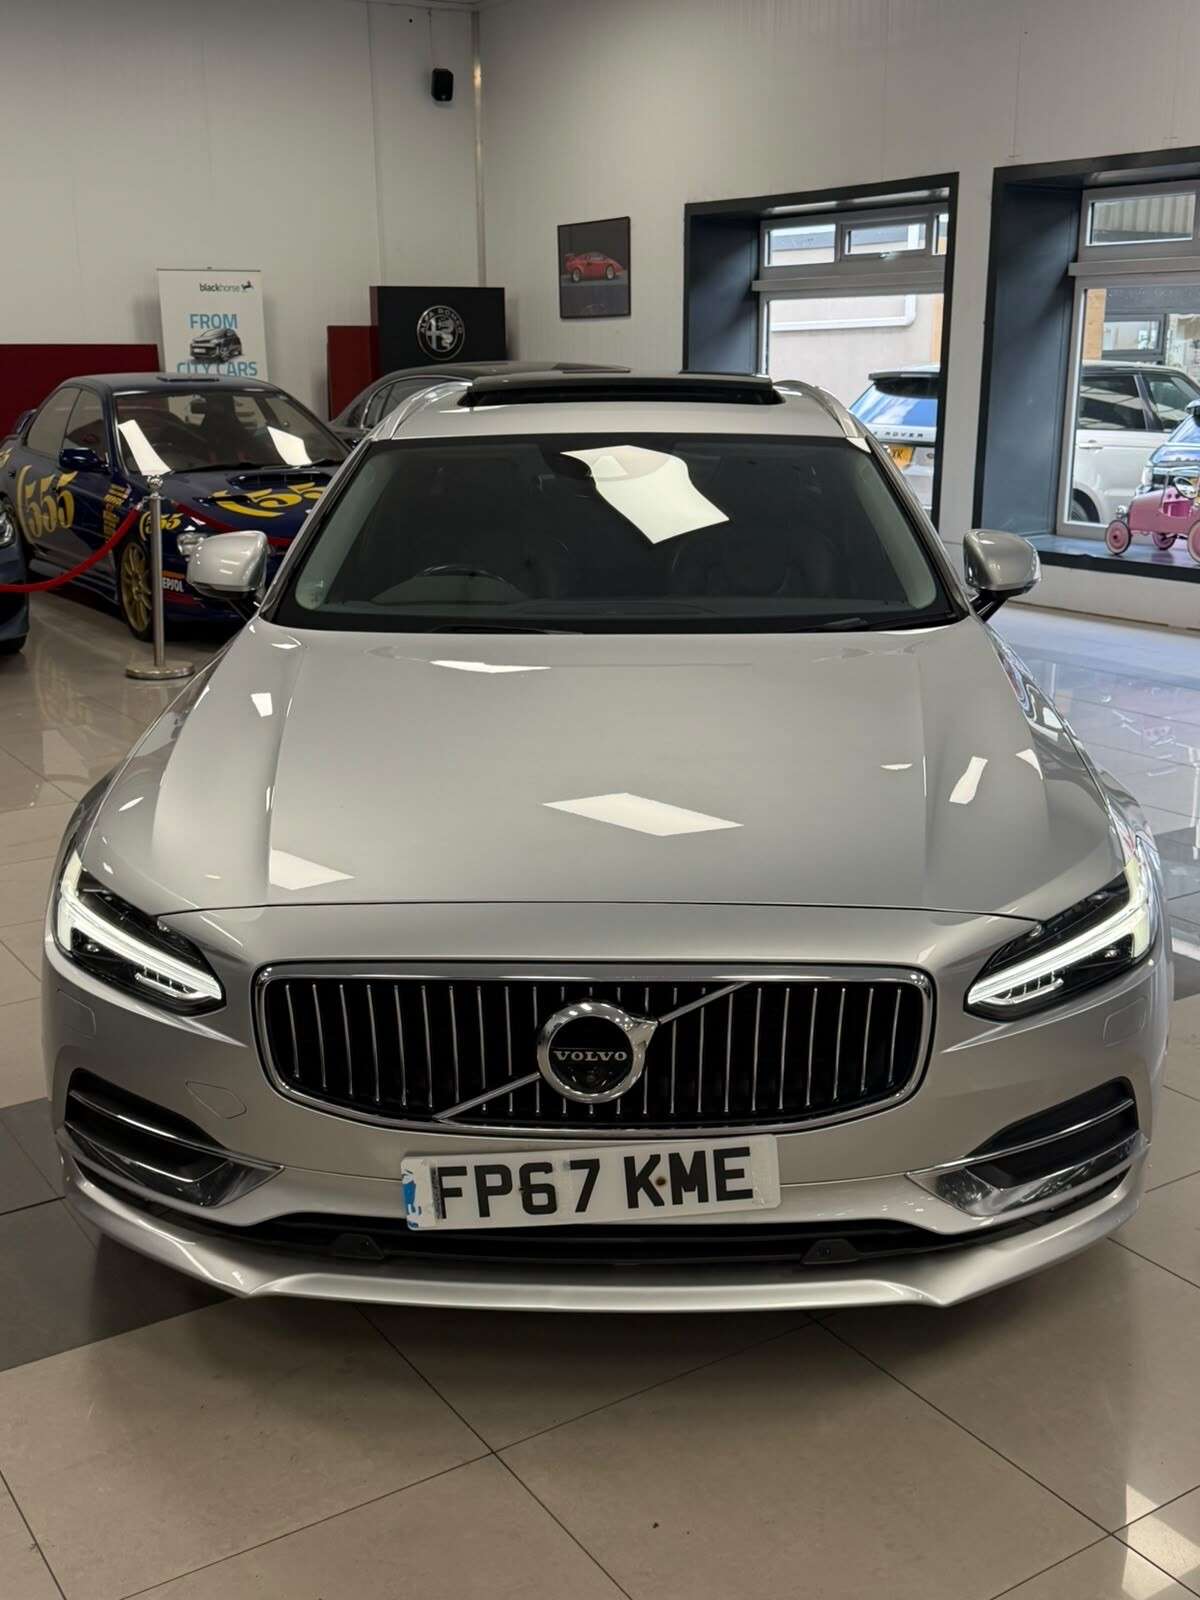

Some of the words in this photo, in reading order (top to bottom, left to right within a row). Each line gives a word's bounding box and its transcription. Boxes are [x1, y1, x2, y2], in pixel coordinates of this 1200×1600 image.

[199, 283, 240, 293] blackhorse
[190, 313, 238, 329] FROM
[177, 362, 210, 374] CITY
[552, 1051, 628, 1061] VOLVO
[435, 1158, 600, 1219] FP67
[623, 1146, 754, 1209] KME
